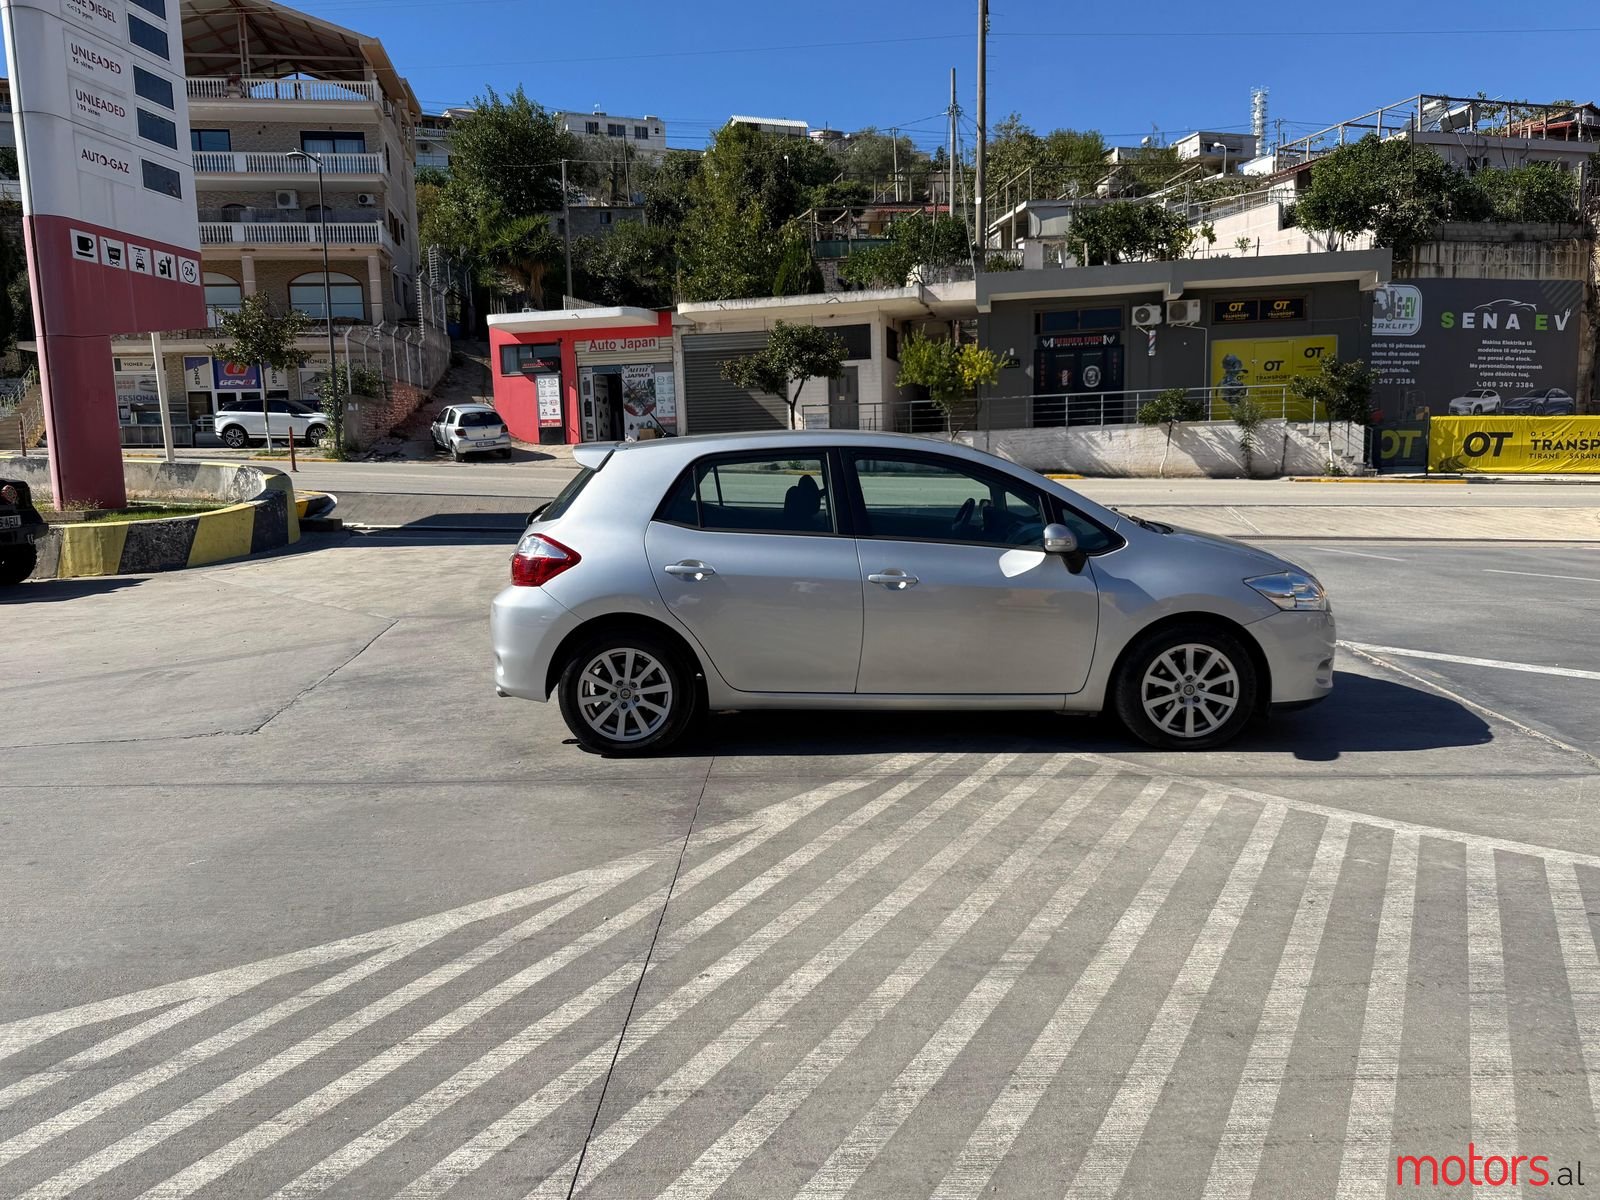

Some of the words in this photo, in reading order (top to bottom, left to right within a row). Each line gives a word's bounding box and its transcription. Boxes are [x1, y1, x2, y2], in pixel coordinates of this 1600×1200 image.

[89, 0, 117, 23] DIESEL
[71, 42, 122, 74] UNLEADED
[75, 89, 126, 117] UNLEADED
[81, 148, 130, 174] AUTO-GAZ
[184, 266, 194, 277] 24
[1228, 302, 1246, 312] OT
[1273, 300, 1291, 310] OT
[1441, 311, 1521, 330] SENA
[1535, 308, 1571, 331] EV
[589, 339, 617, 350] Auto
[620, 338, 656, 351] Japan
[1304, 347, 1325, 358] OT
[1263, 360, 1285, 371] OT
[1463, 431, 1514, 458] OT
